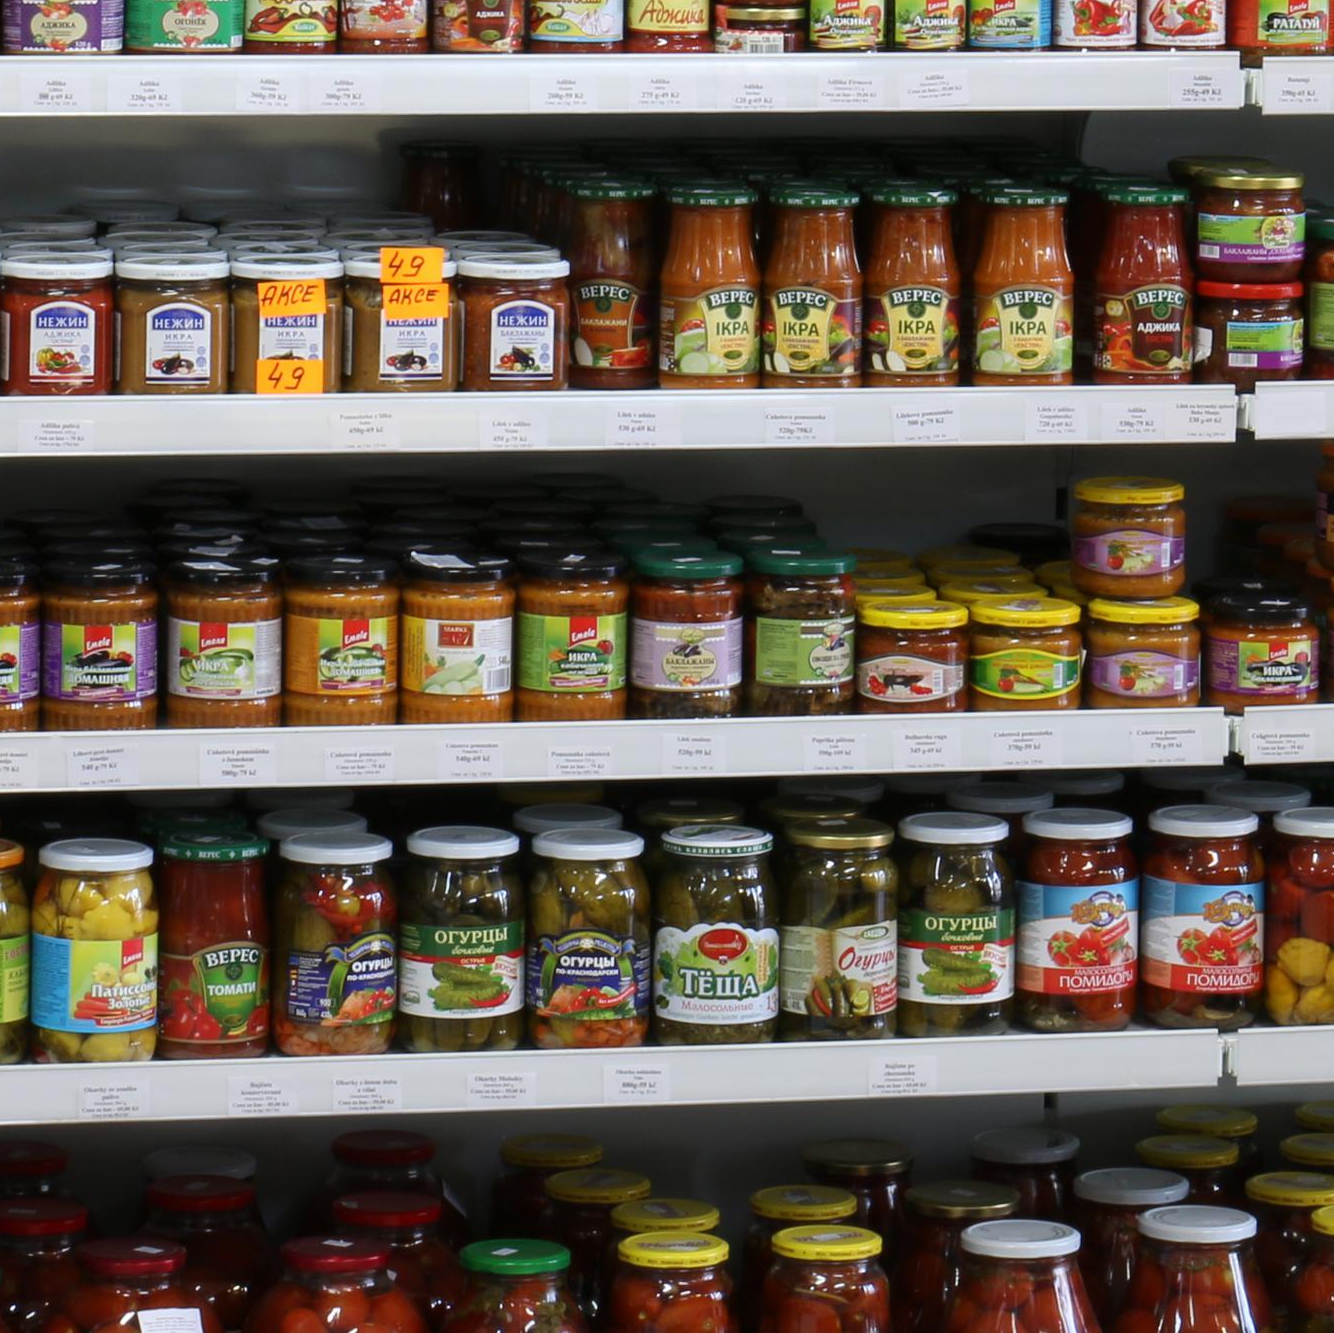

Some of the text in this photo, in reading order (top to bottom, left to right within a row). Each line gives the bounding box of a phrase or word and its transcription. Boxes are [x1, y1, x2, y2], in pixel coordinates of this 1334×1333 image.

[642, 0, 706, 25] Аджика
[40, 21, 76, 30] АДЖИКА
[174, 17, 207, 27] ОГОНЁК
[387, 256, 425, 277] 49
[581, 285, 630, 301] ВЕРЕС
[777, 291, 828, 307] ВЕРЕС
[782, 319, 818, 337] ІКРА
[268, 369, 305, 389] 49
[568, 651, 597, 663] ИКРА
[434, 928, 508, 944] ОГУРЦЫ
[1059, 970, 1133, 988] ПОМИДОРЫ
[208, 982, 257, 996] ТОМАТИ
